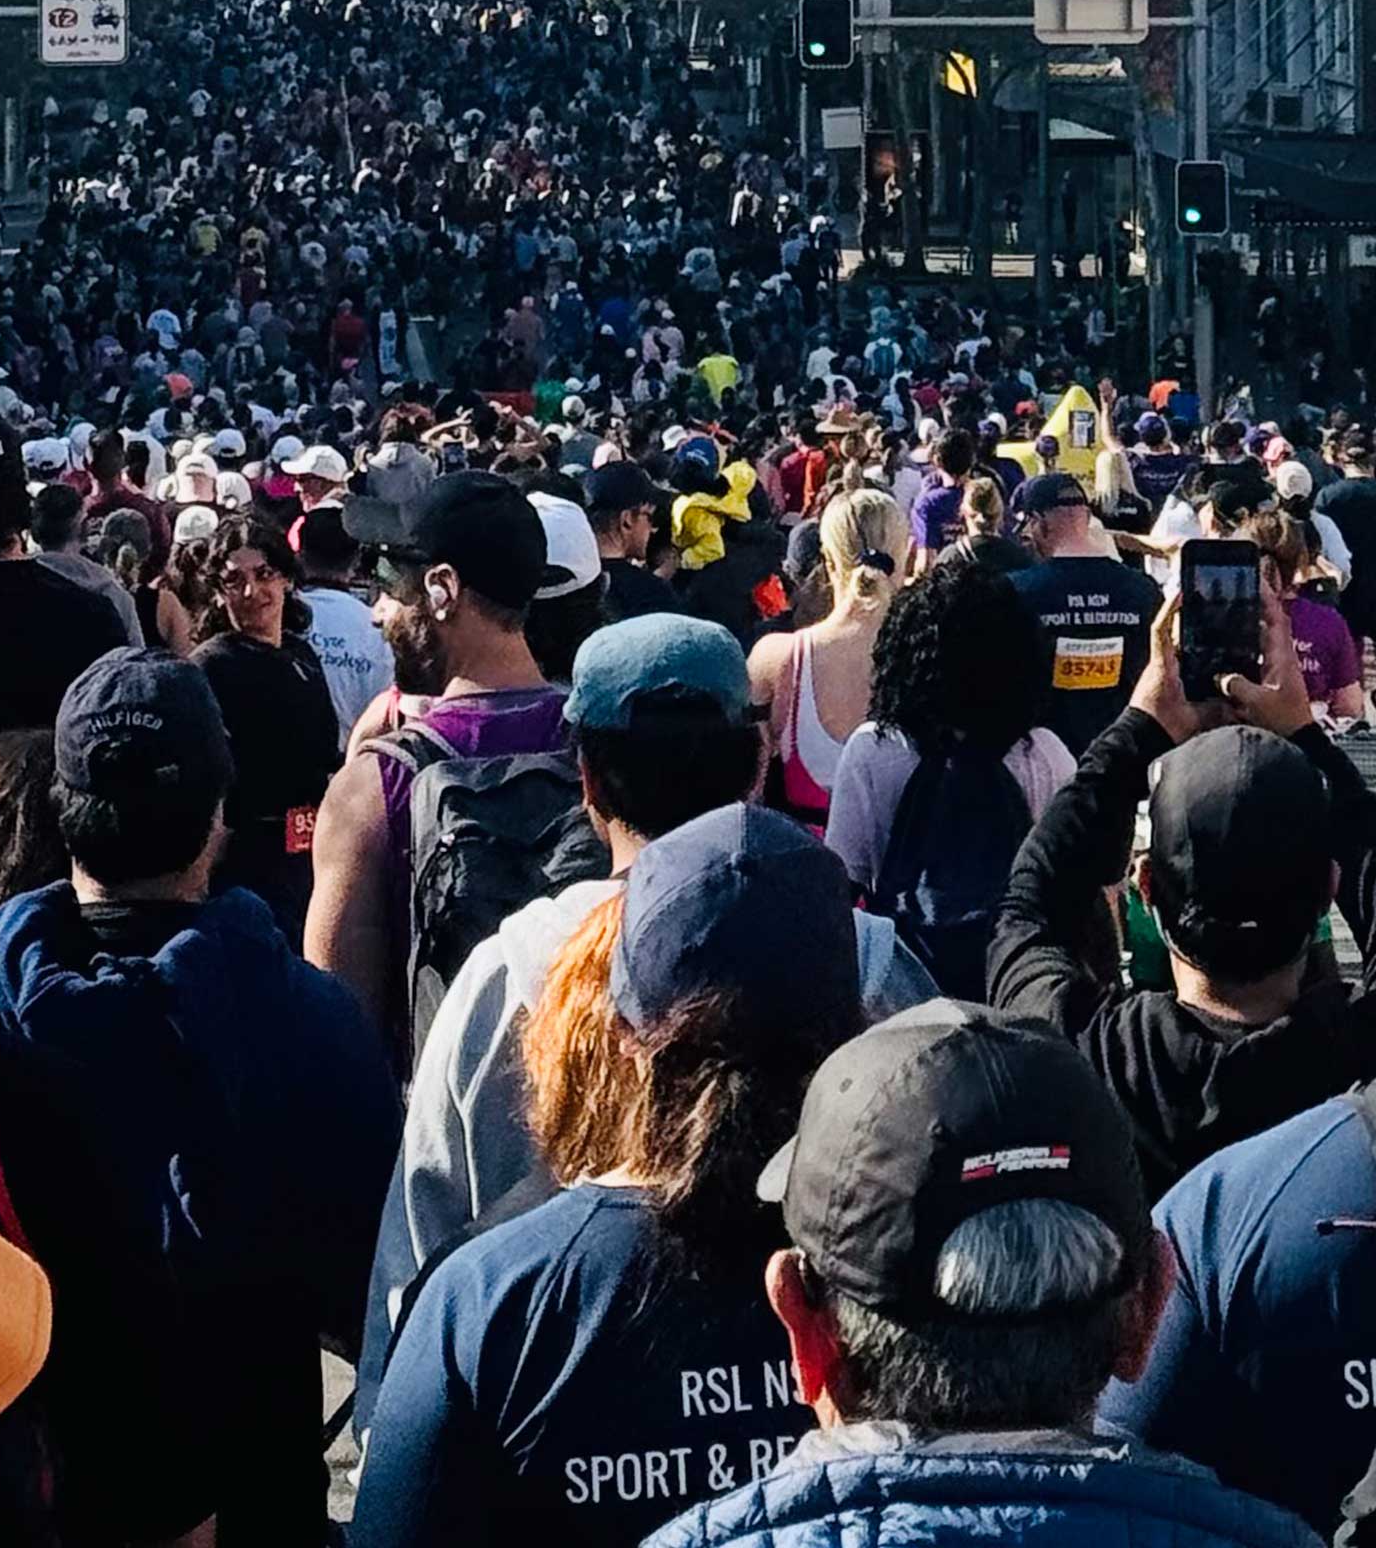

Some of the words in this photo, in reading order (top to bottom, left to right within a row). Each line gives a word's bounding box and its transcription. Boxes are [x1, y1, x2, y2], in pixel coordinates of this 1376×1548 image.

[680, 1364, 754, 1419] RSL
[565, 1446, 693, 1505] SPORT
[707, 1443, 737, 1492] &
